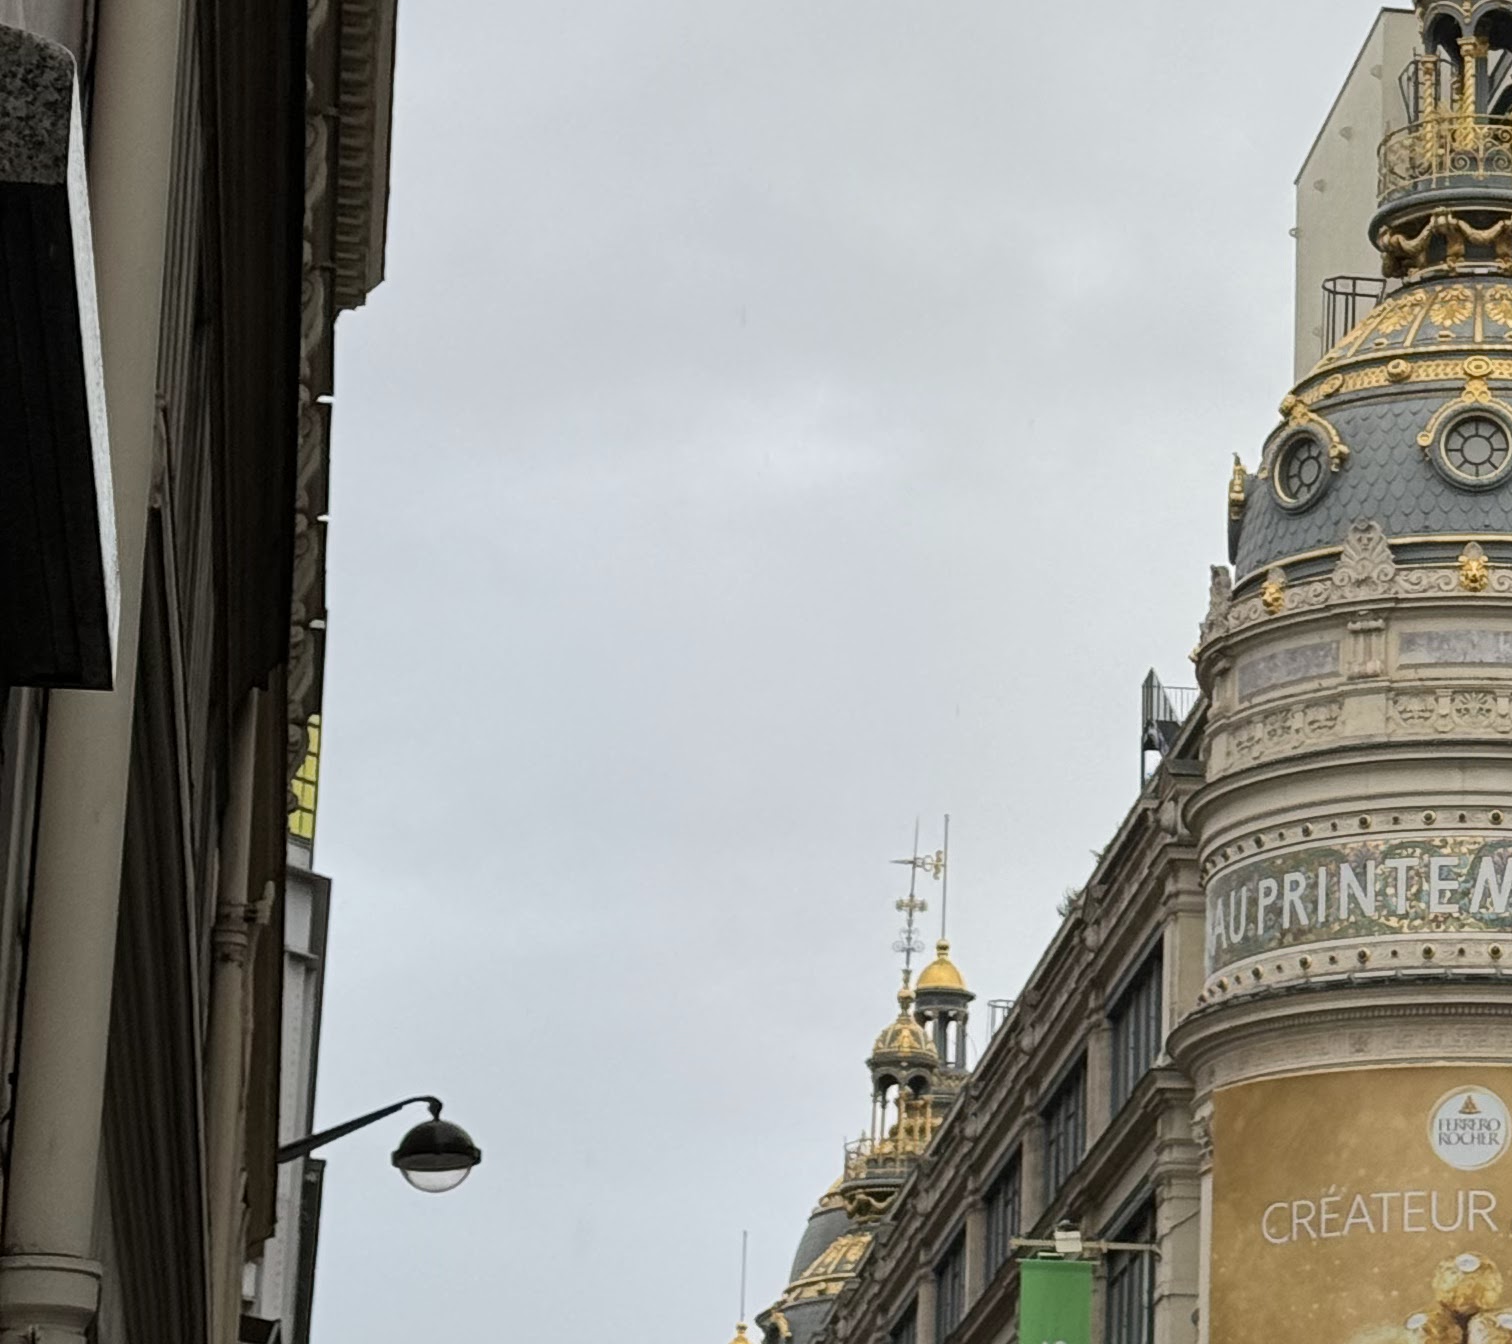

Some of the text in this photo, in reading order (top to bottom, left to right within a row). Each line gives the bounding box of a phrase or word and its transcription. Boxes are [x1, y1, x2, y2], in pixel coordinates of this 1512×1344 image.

[1209, 886, 1247, 956] AU
[1438, 1118, 1501, 1132] FERRERO
[1438, 1131, 1500, 1146] ROCHER
[1262, 1184, 1498, 1244] CRÉATEUR
